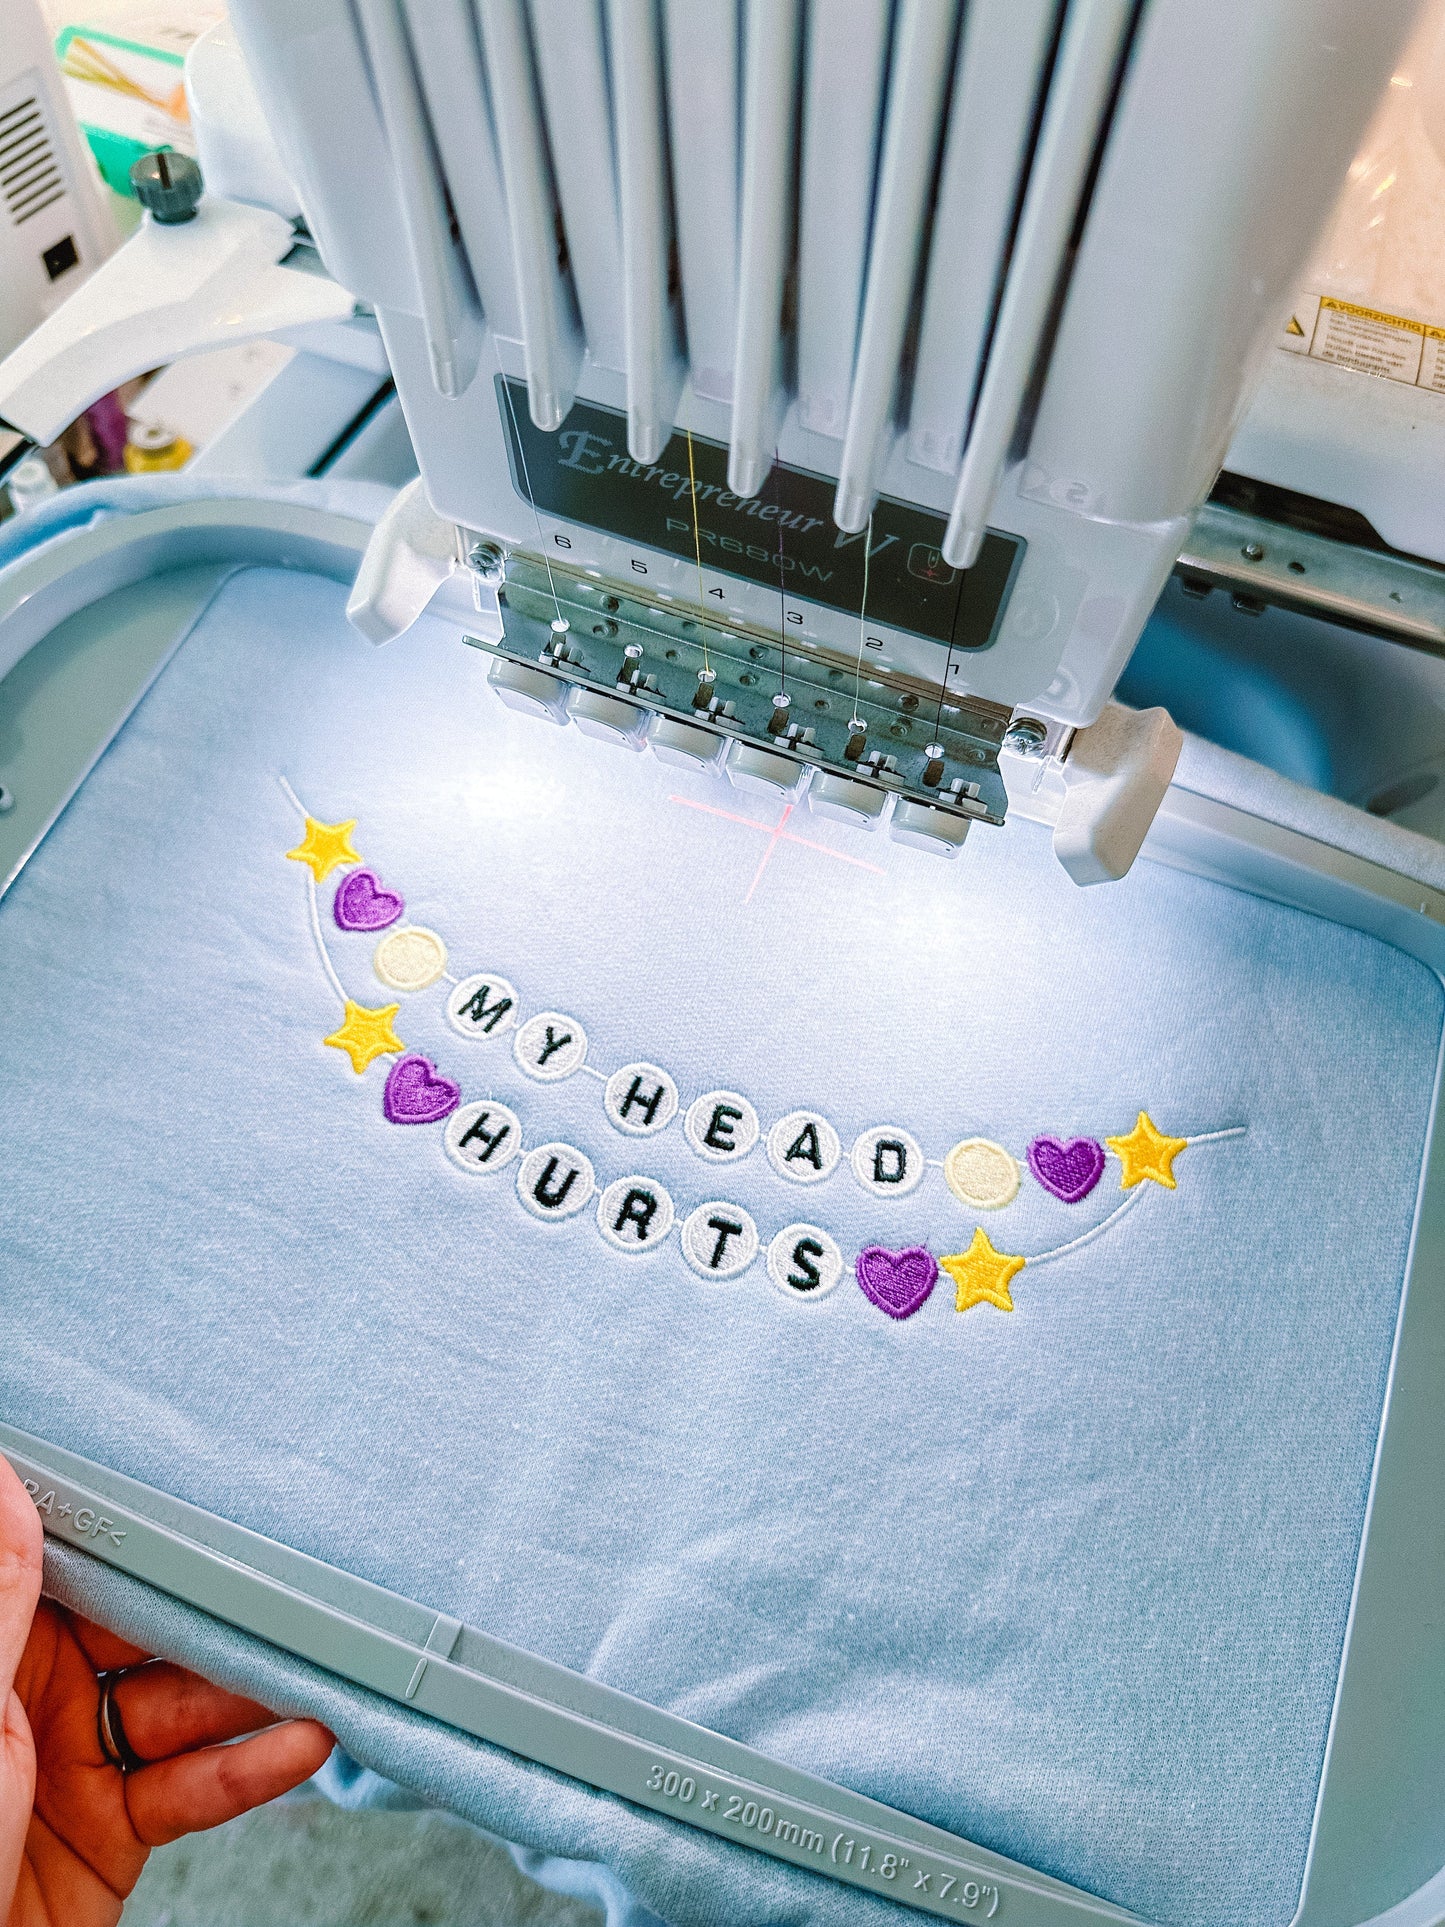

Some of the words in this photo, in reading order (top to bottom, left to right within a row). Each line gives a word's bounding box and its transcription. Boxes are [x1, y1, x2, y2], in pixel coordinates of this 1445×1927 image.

[1337, 303, 1421, 332] VOORZICHTIG
[558, 430, 824, 533] Entrepreneur
[554, 534, 572, 549] 6
[631, 559, 648, 574] 5
[708, 587, 726, 600] 4
[786, 611, 804, 625] 3
[865, 636, 884, 651] 2
[666, 518, 833, 582] PR680W
[457, 984, 572, 1066] MY
[620, 1075, 907, 1184] HEAD
[458, 1112, 824, 1291] HURTS
[646, 1764, 697, 1803] 300
[701, 1788, 720, 1812] x
[723, 1795, 825, 1854] 200mm
[830, 1832, 909, 1881] (11.8"
[914, 1869, 931, 1893] x
[939, 1872, 1000, 1918] 7.9")
